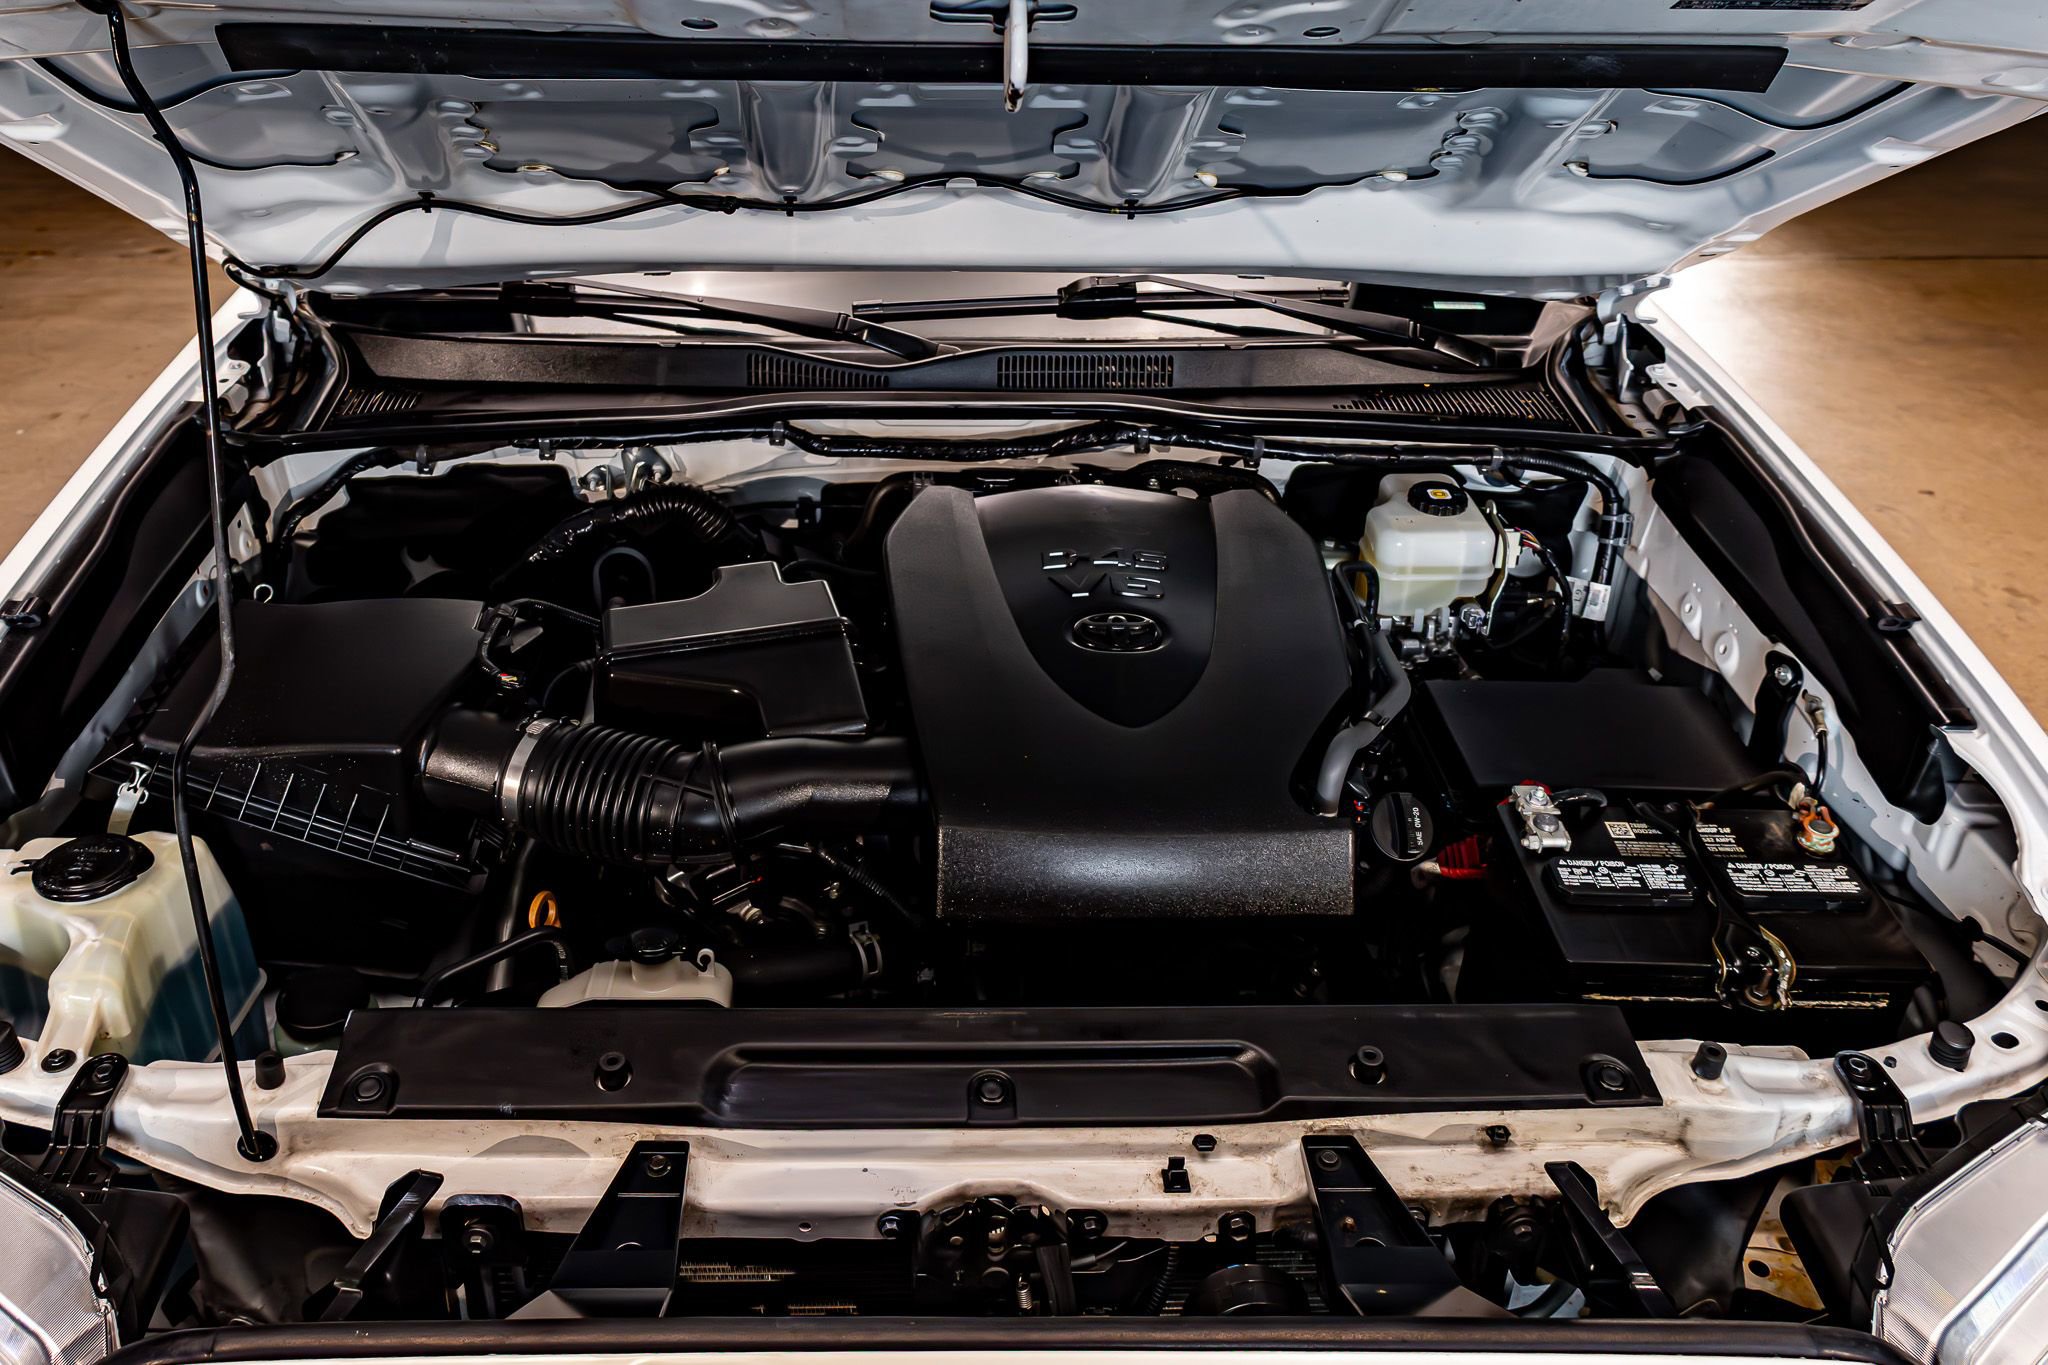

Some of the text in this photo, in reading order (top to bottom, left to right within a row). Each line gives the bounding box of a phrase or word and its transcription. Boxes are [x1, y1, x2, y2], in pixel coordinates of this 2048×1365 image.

[1047, 572, 1166, 599] V6
[1415, 831, 1424, 846] SAE
[1567, 859, 1595, 867] DANGER
